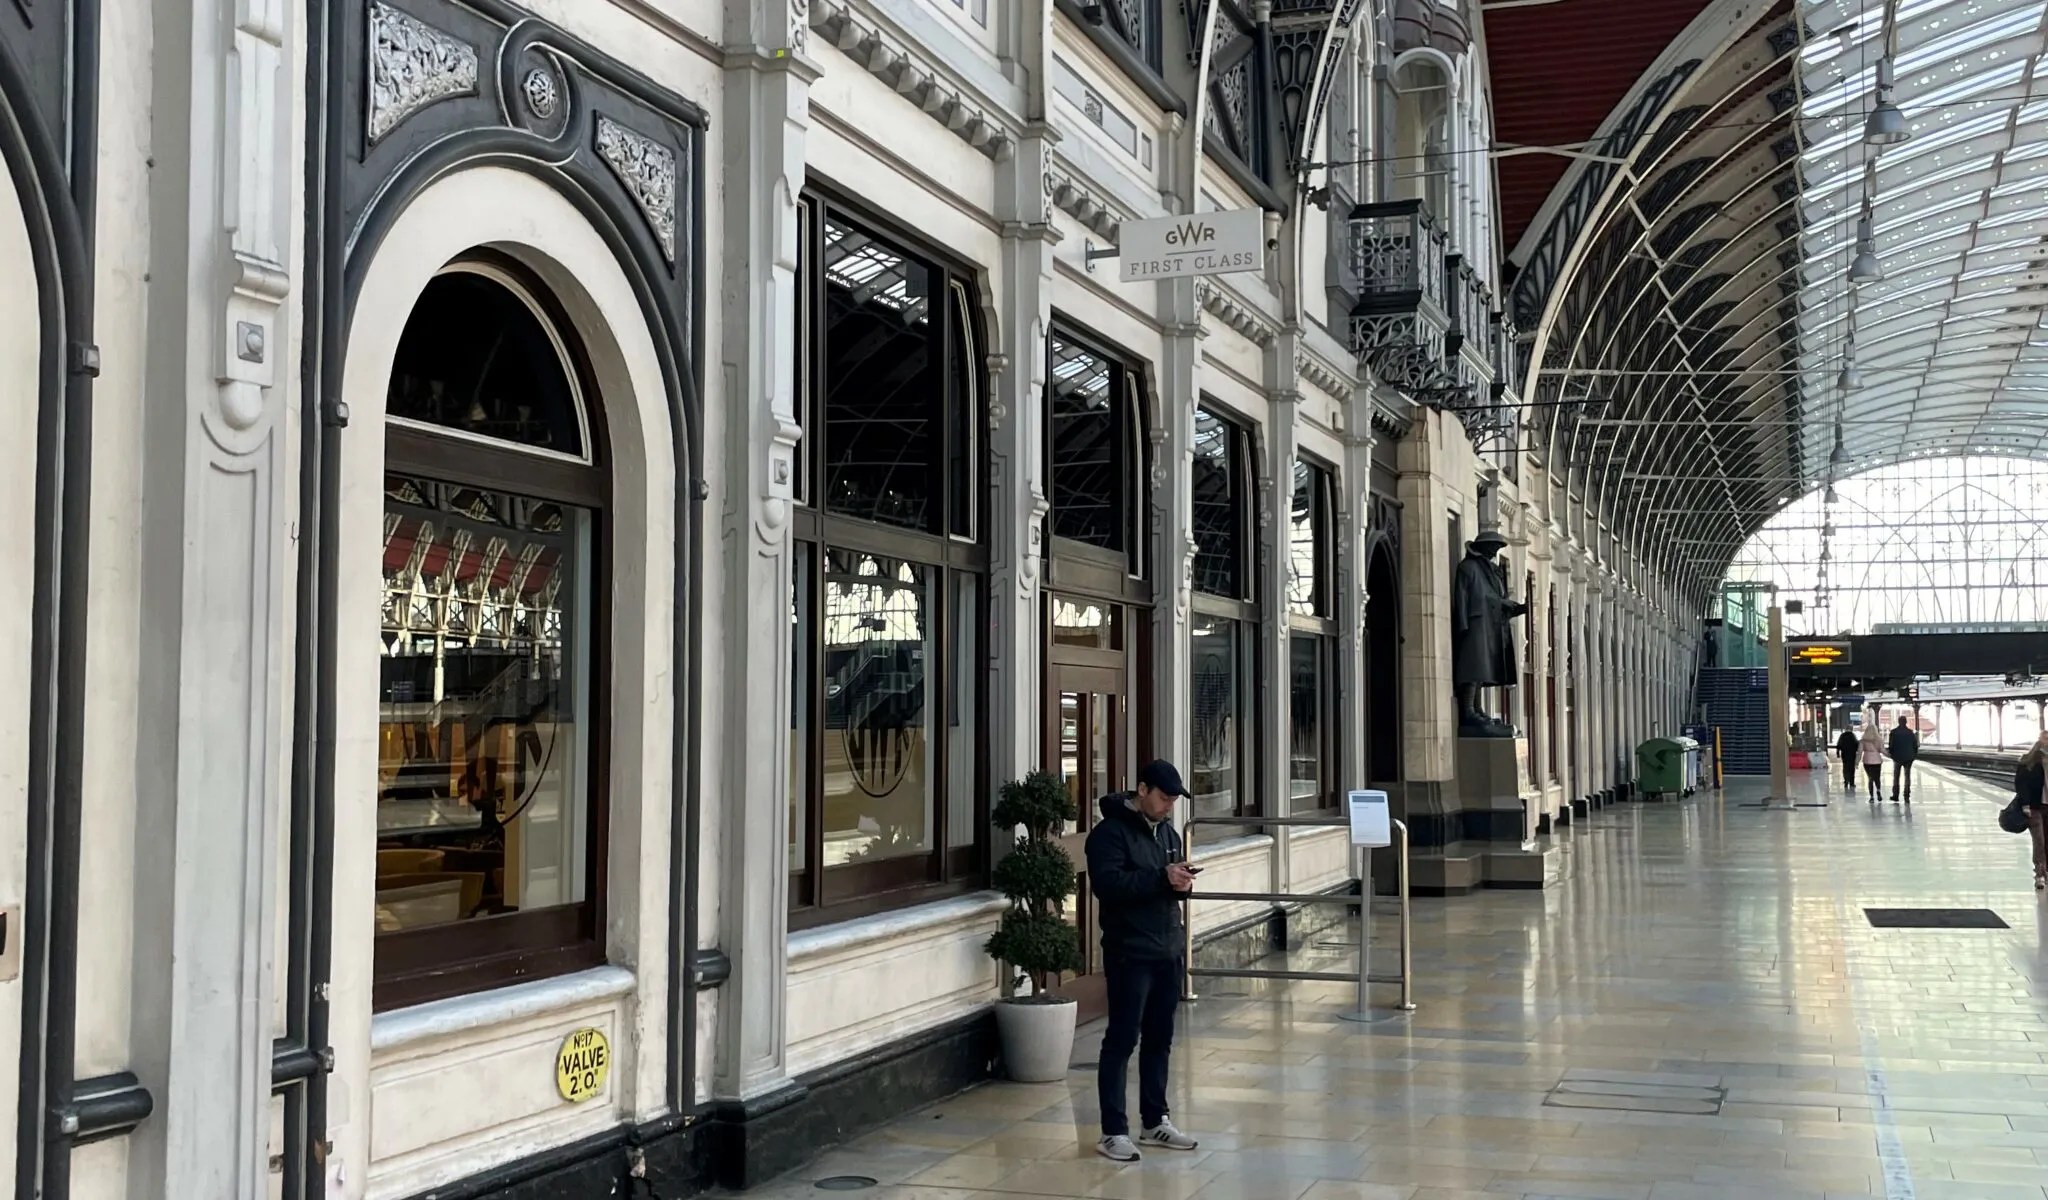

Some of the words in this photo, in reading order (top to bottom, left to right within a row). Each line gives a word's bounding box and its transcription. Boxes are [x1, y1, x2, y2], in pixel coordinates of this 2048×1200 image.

[1165, 219, 1216, 246] GWR
[1130, 258, 1184, 276] FIRST
[1194, 252, 1253, 269] CLASS
[563, 1045, 604, 1075] VALVE
